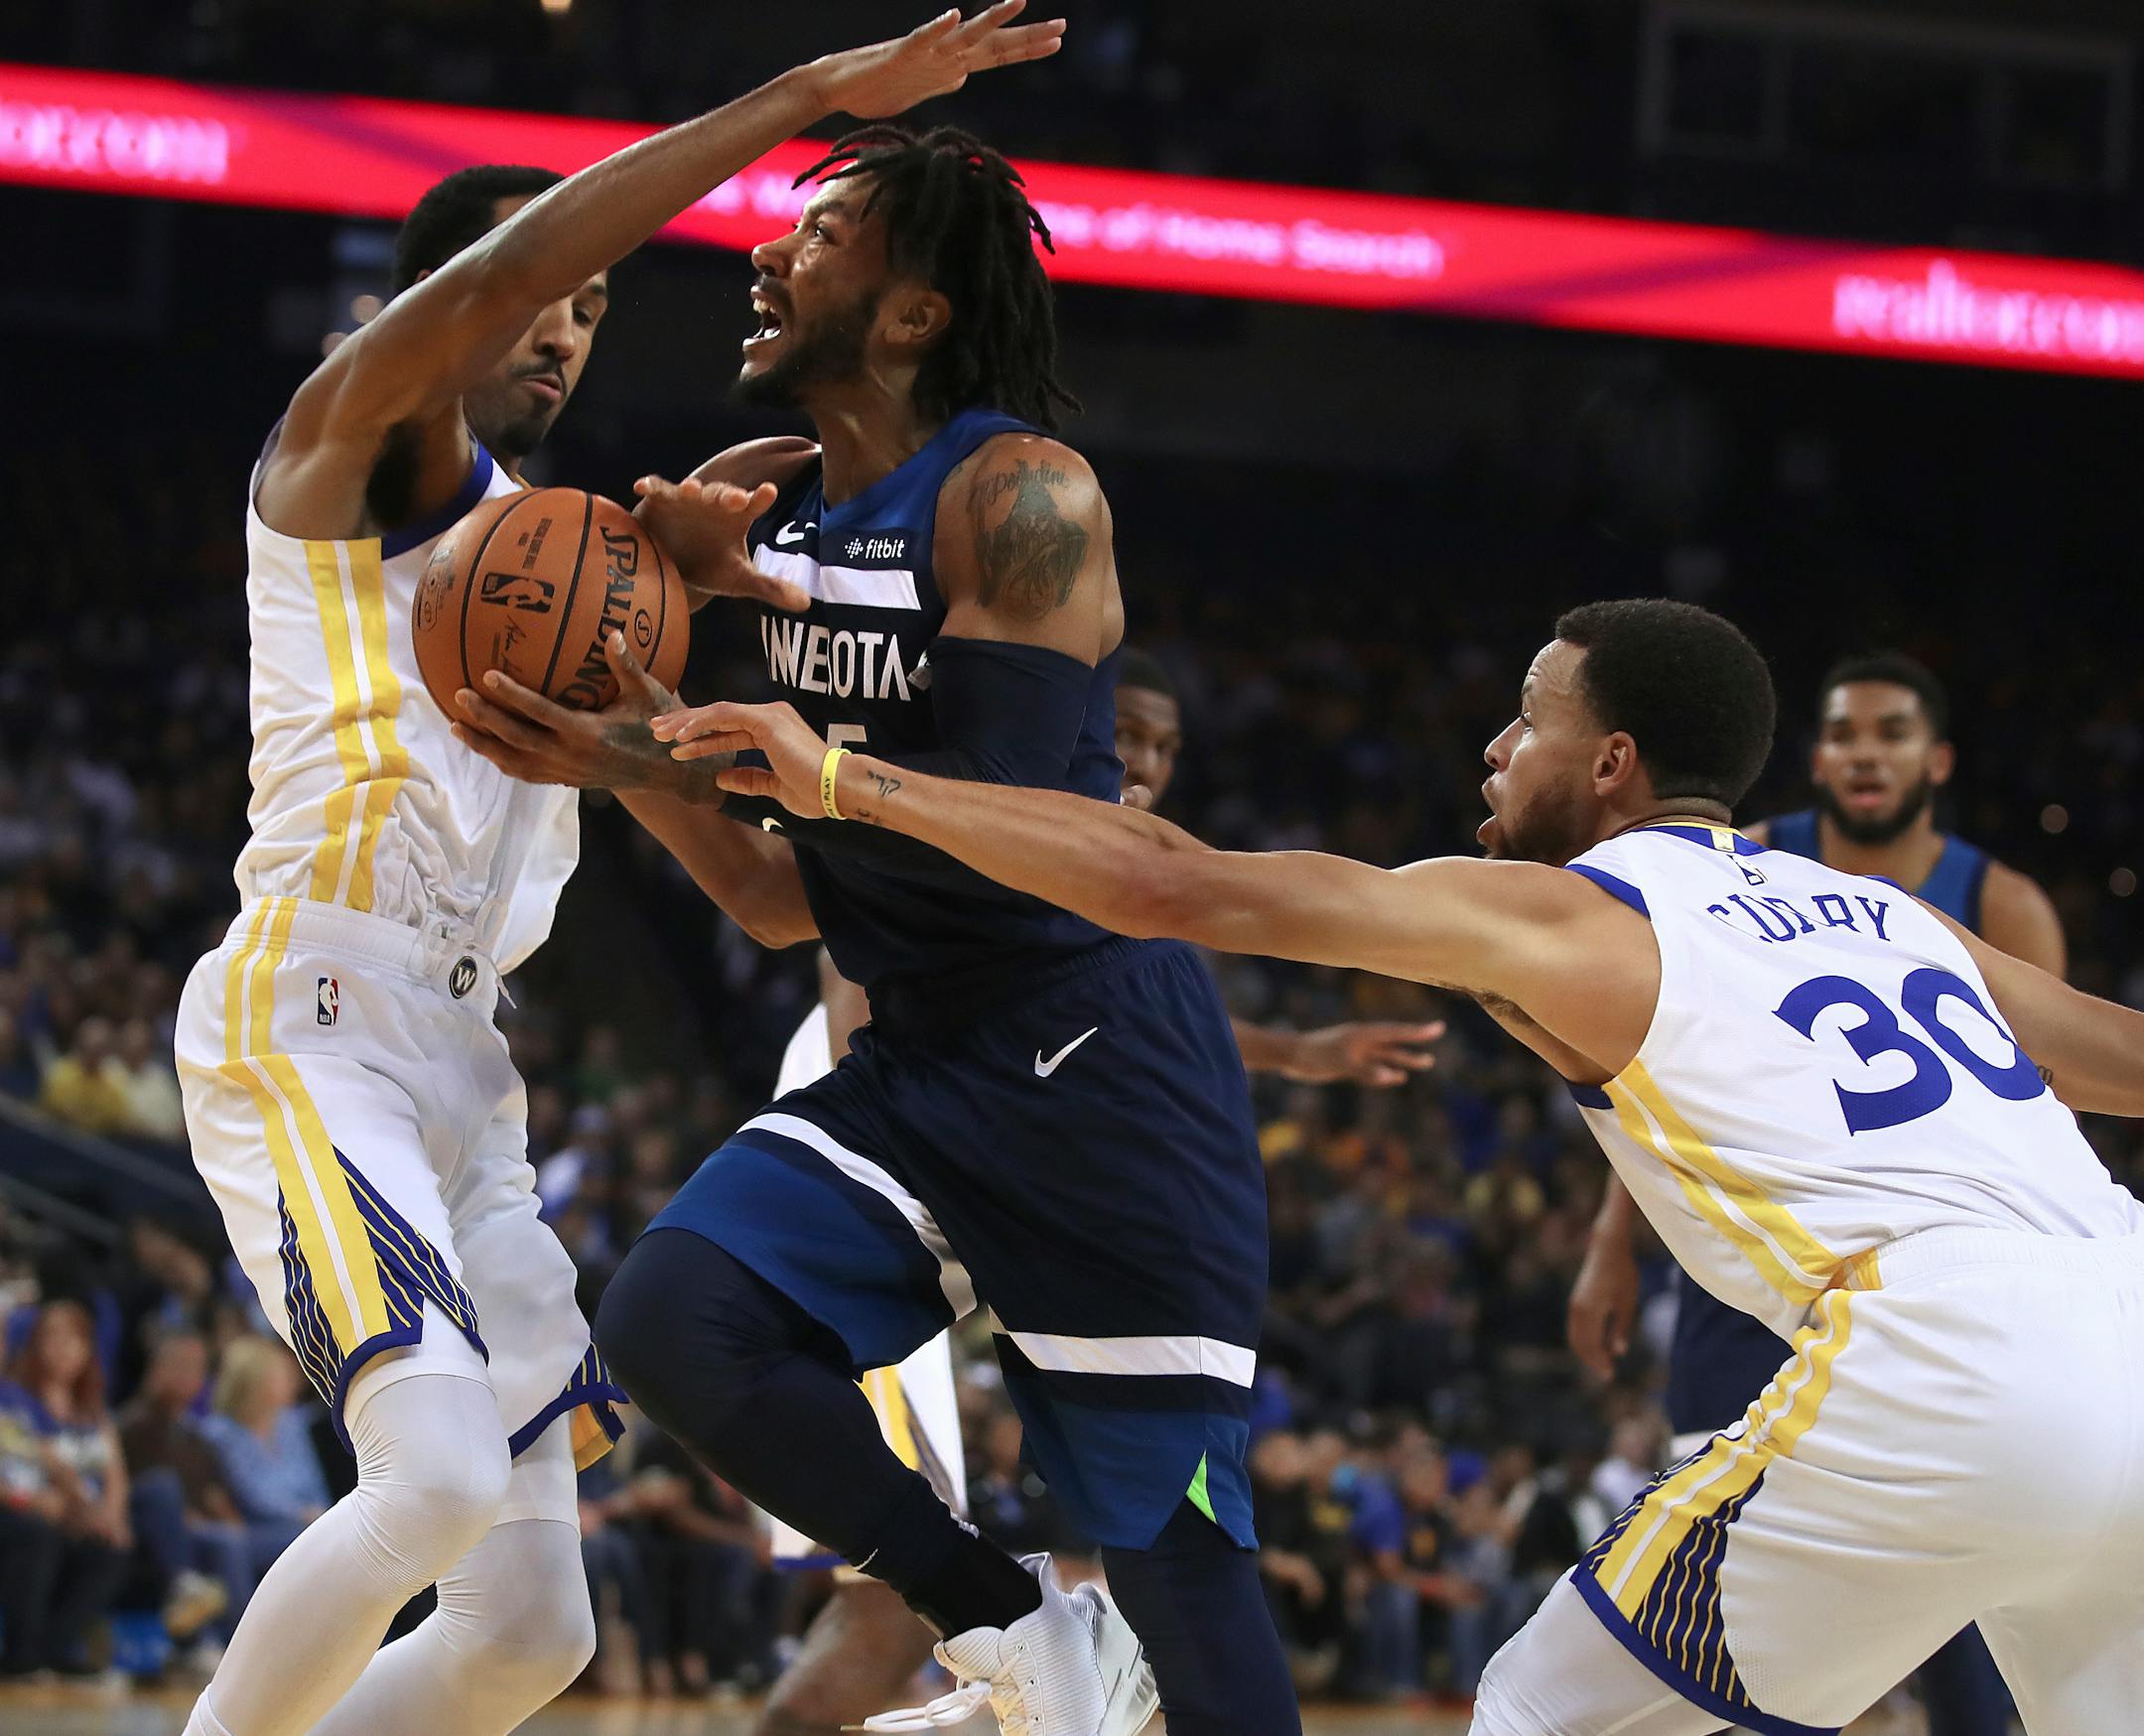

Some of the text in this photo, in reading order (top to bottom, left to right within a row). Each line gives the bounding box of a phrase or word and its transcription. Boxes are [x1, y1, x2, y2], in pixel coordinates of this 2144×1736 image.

[556, 525, 639, 711] SPALDING
[865, 538, 905, 559] fitbit
[1772, 968, 2047, 1137] 30
